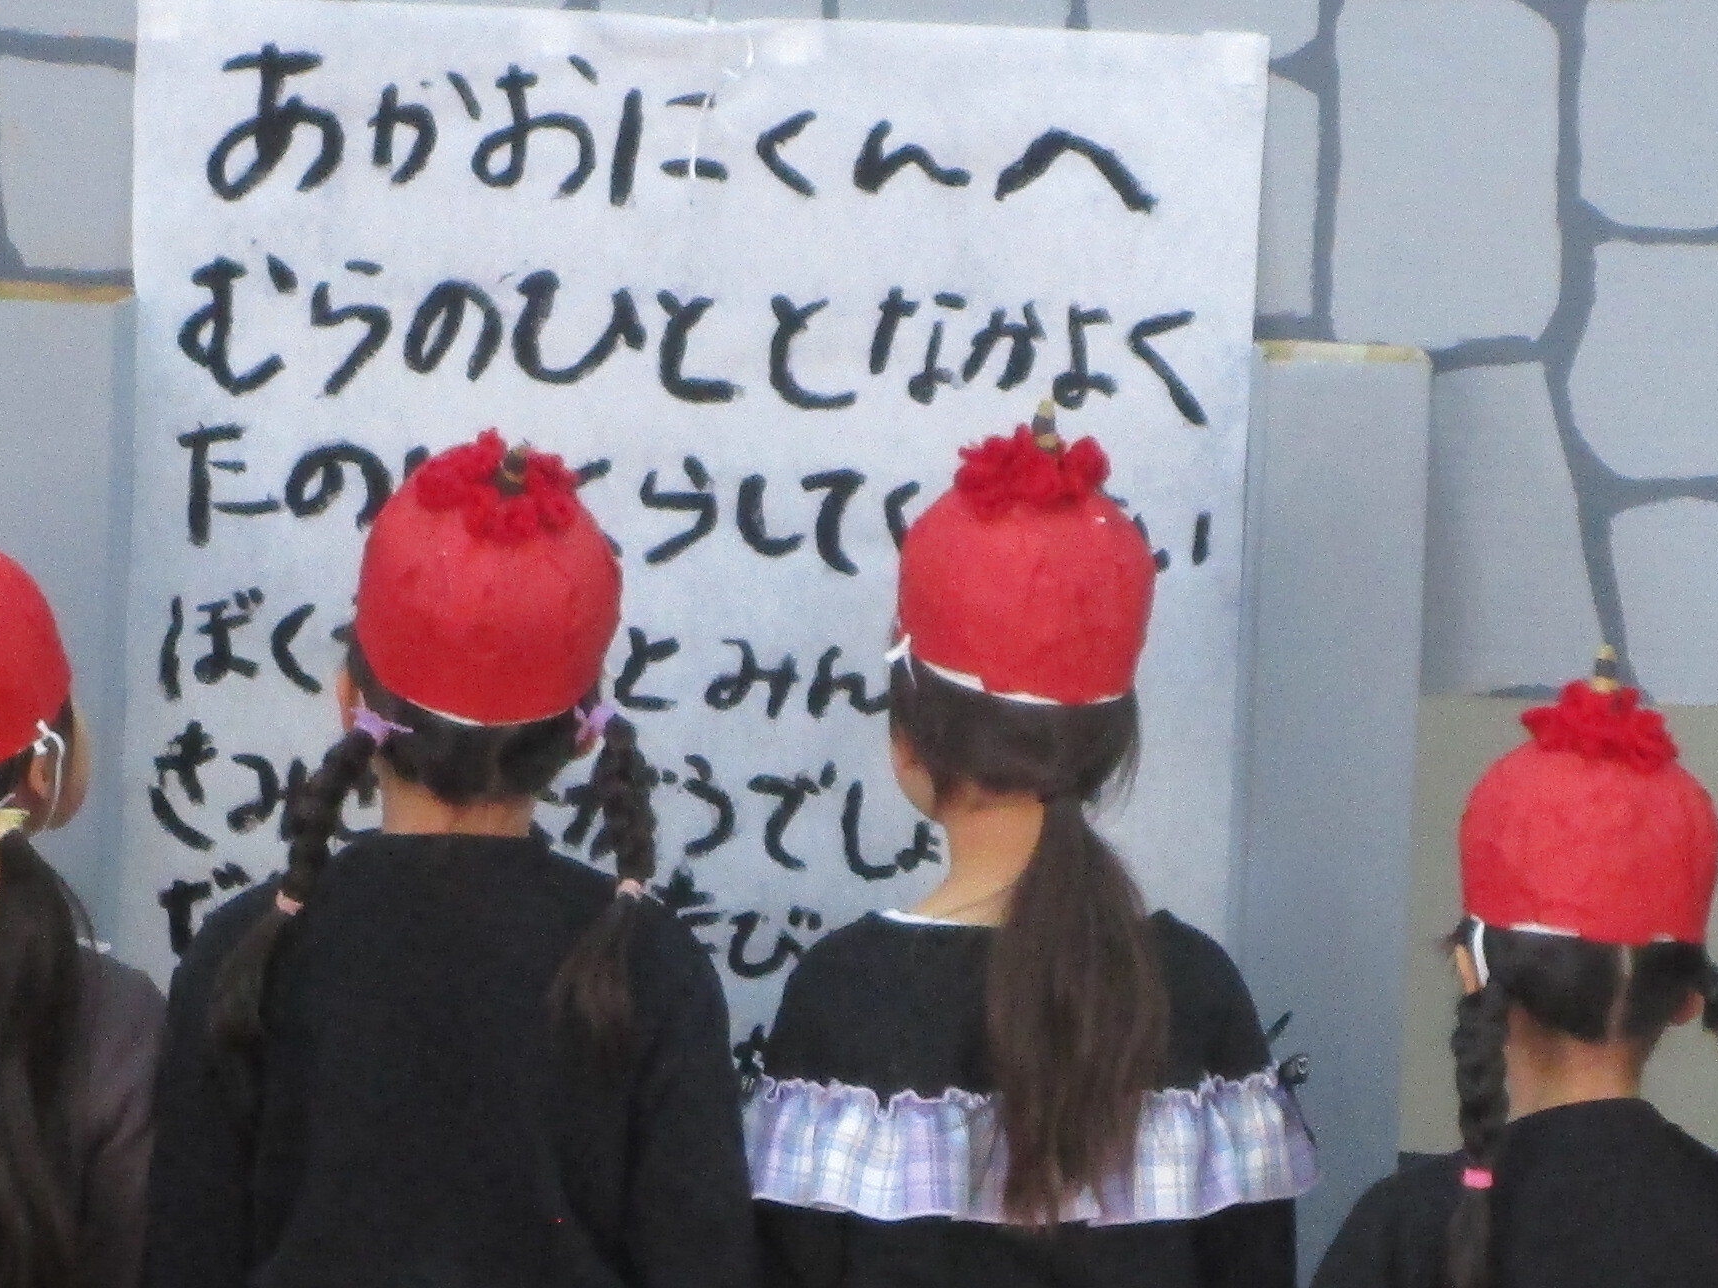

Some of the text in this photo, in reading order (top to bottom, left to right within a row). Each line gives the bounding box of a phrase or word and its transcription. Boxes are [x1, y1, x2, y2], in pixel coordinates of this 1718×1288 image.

[206, 43, 1159, 213] あかおにくんへ
[177, 255, 1207, 426] むらのひととなかよく
